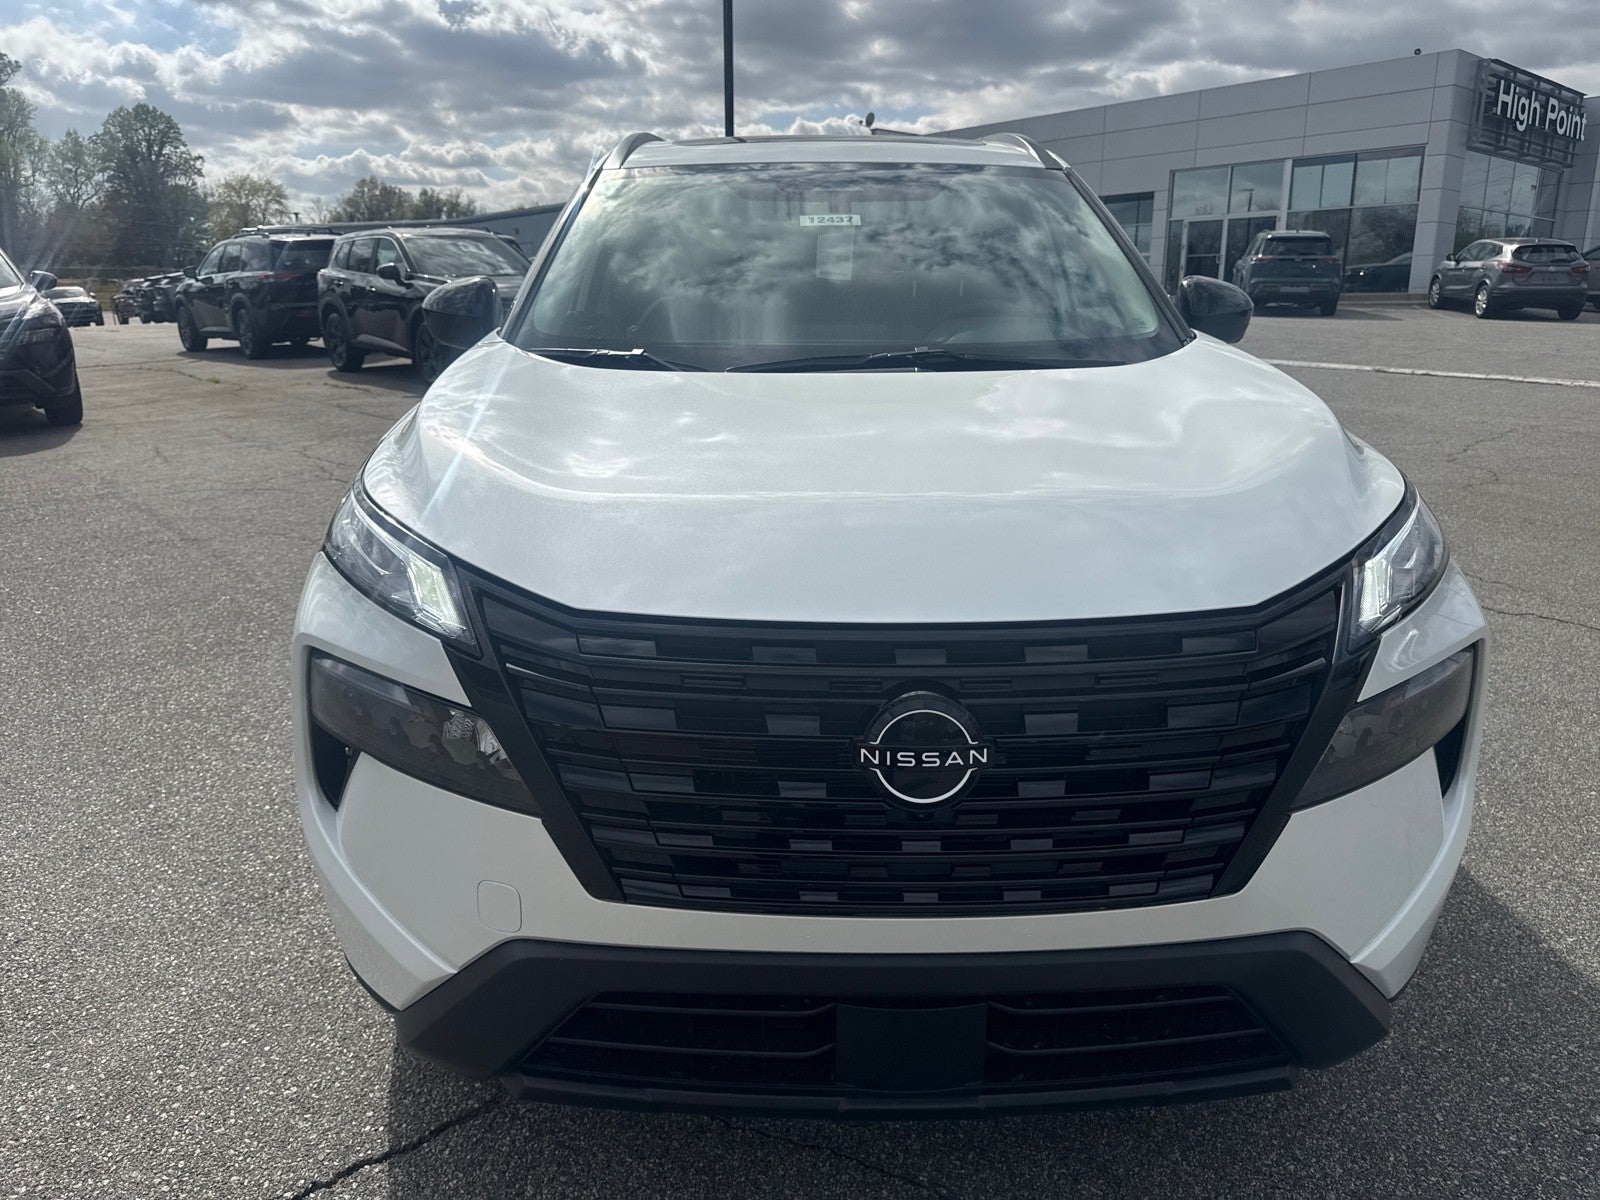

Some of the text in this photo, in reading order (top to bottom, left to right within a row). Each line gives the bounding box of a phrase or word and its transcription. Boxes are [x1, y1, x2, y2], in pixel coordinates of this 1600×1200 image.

[1497, 80, 1587, 141] High Point
[807, 216, 853, 224] 12437
[860, 748, 987, 767] NISSAN
